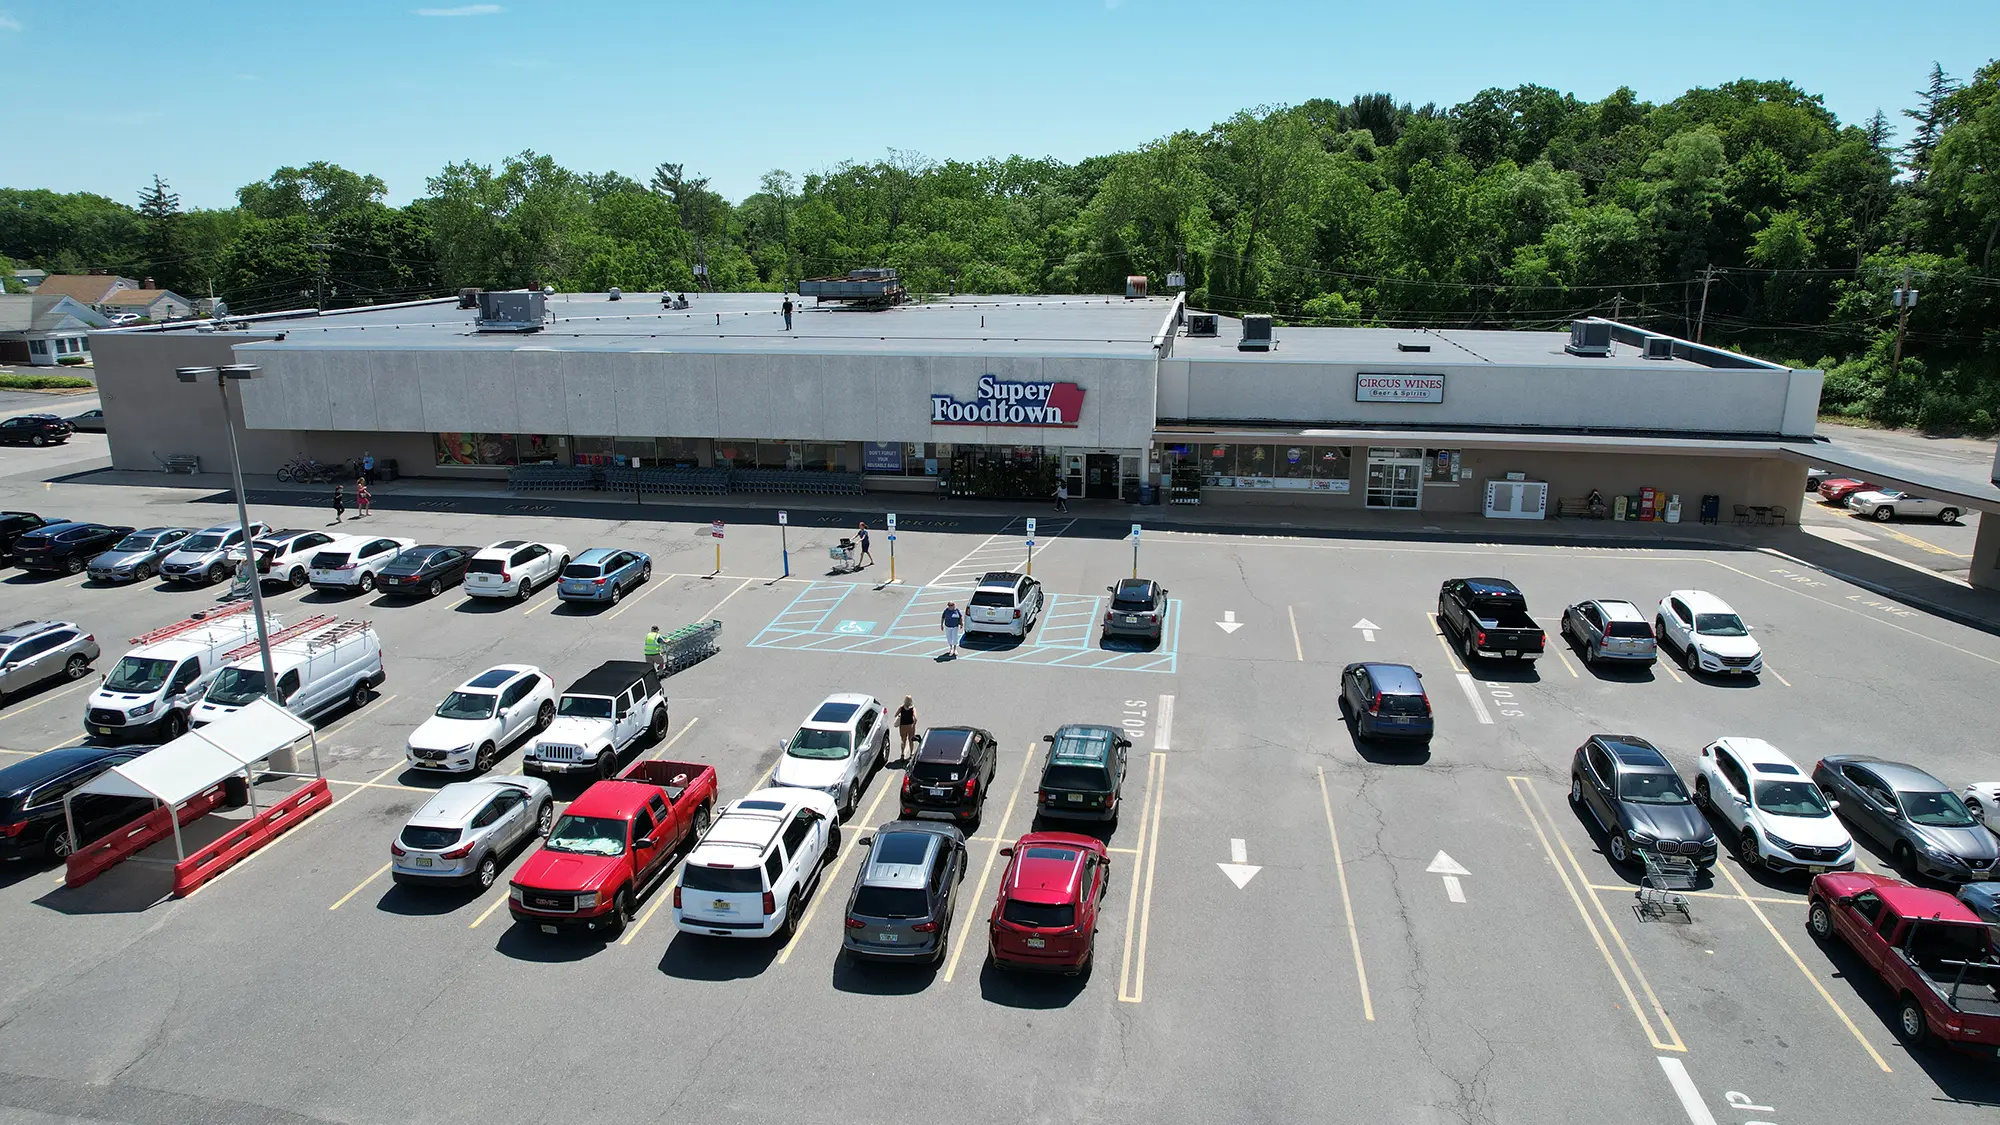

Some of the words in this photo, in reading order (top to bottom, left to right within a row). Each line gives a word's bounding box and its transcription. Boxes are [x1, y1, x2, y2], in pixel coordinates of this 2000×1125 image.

[978, 376, 1049, 405] Super
[1359, 378, 1401, 388] CIRCUS
[1404, 379, 1442, 389] WINES
[931, 397, 1063, 424] Foodtown
[872, 517, 960, 527] PRKING
[1770, 568, 1827, 587] FIRE
[1845, 595, 1919, 617] LANE
[1486, 682, 1525, 717] STOP
[1122, 700, 1148, 738] STOP
[535, 898, 559, 906] GMC
